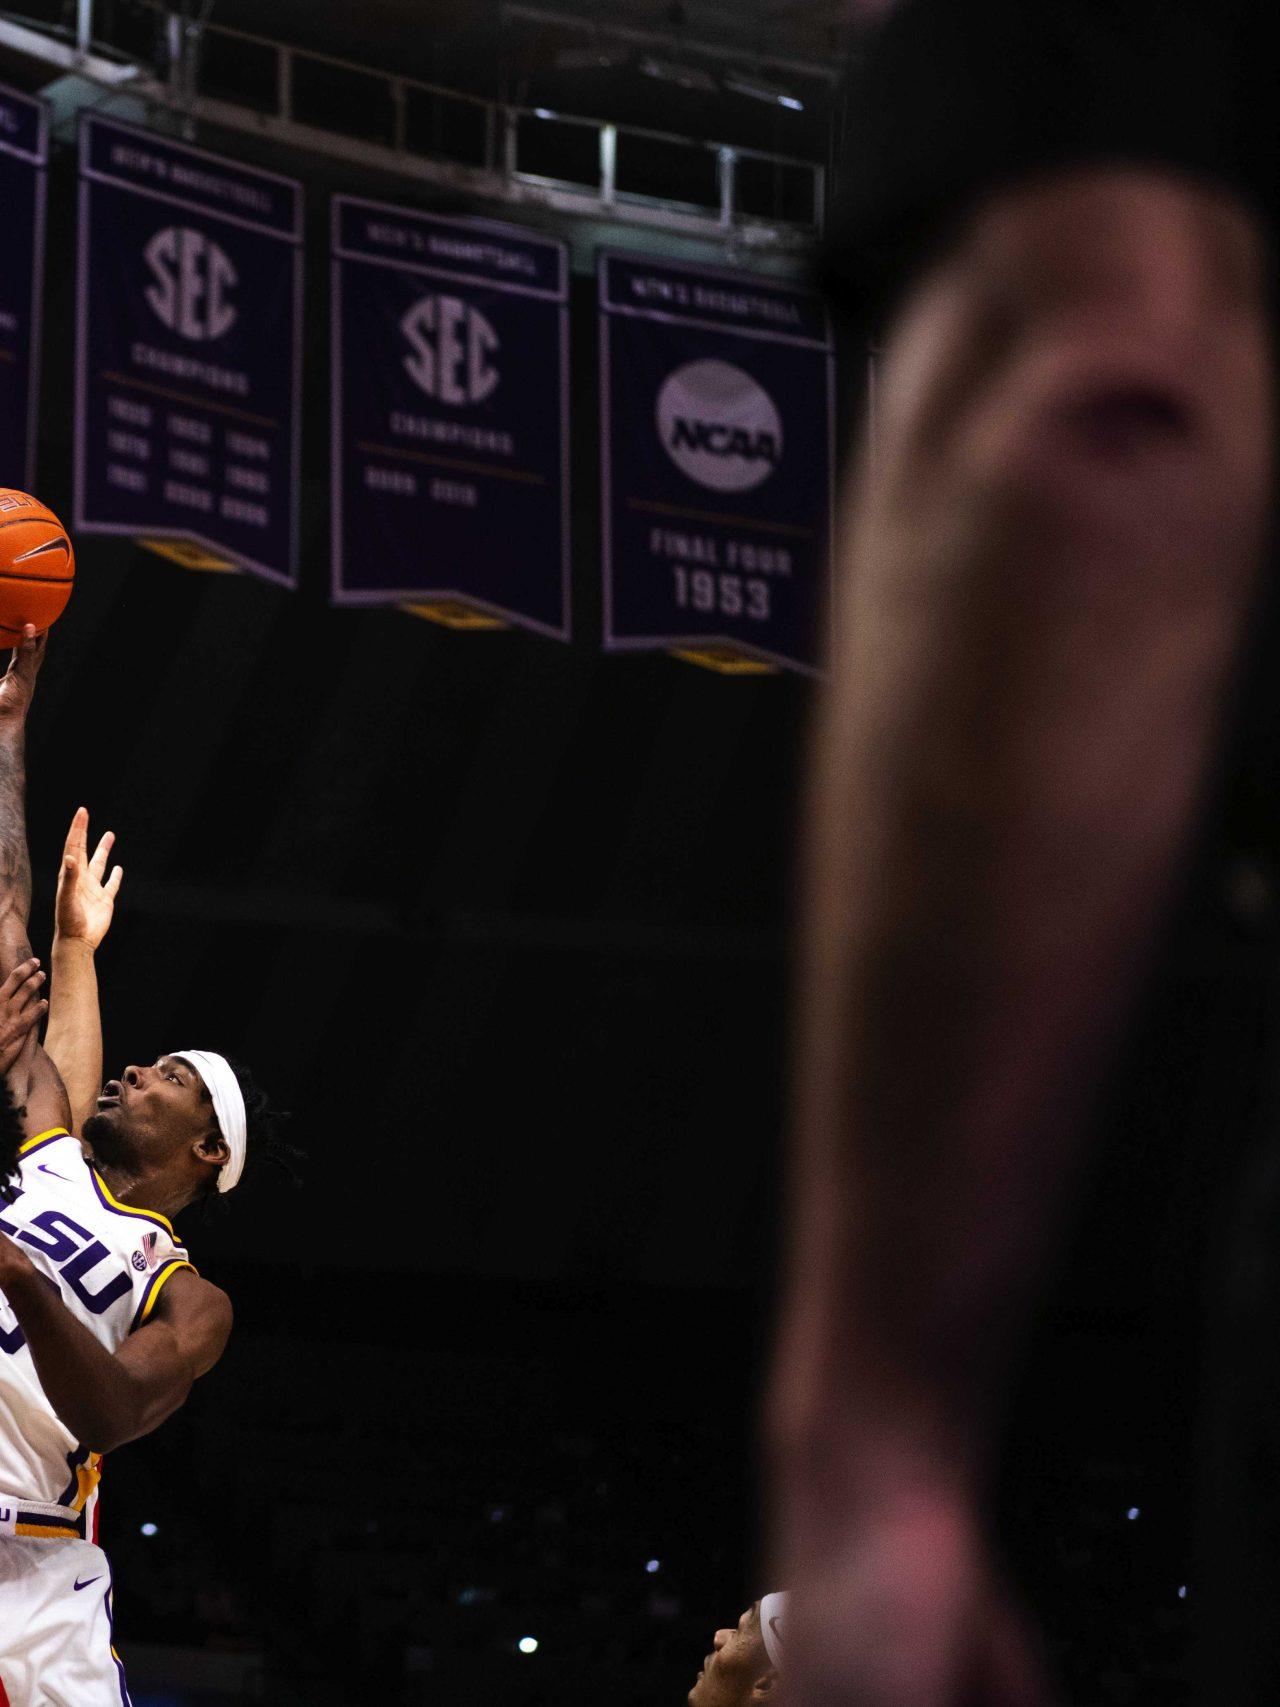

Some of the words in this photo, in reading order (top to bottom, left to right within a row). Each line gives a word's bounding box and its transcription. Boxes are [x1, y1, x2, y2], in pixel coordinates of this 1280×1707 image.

[142, 225, 239, 340] SEC
[398, 294, 500, 406] SEC
[672, 419, 776, 462] NCAA
[649, 526, 719, 566] FINAL
[725, 538, 793, 577] FOUR
[673, 564, 770, 622] 1953
